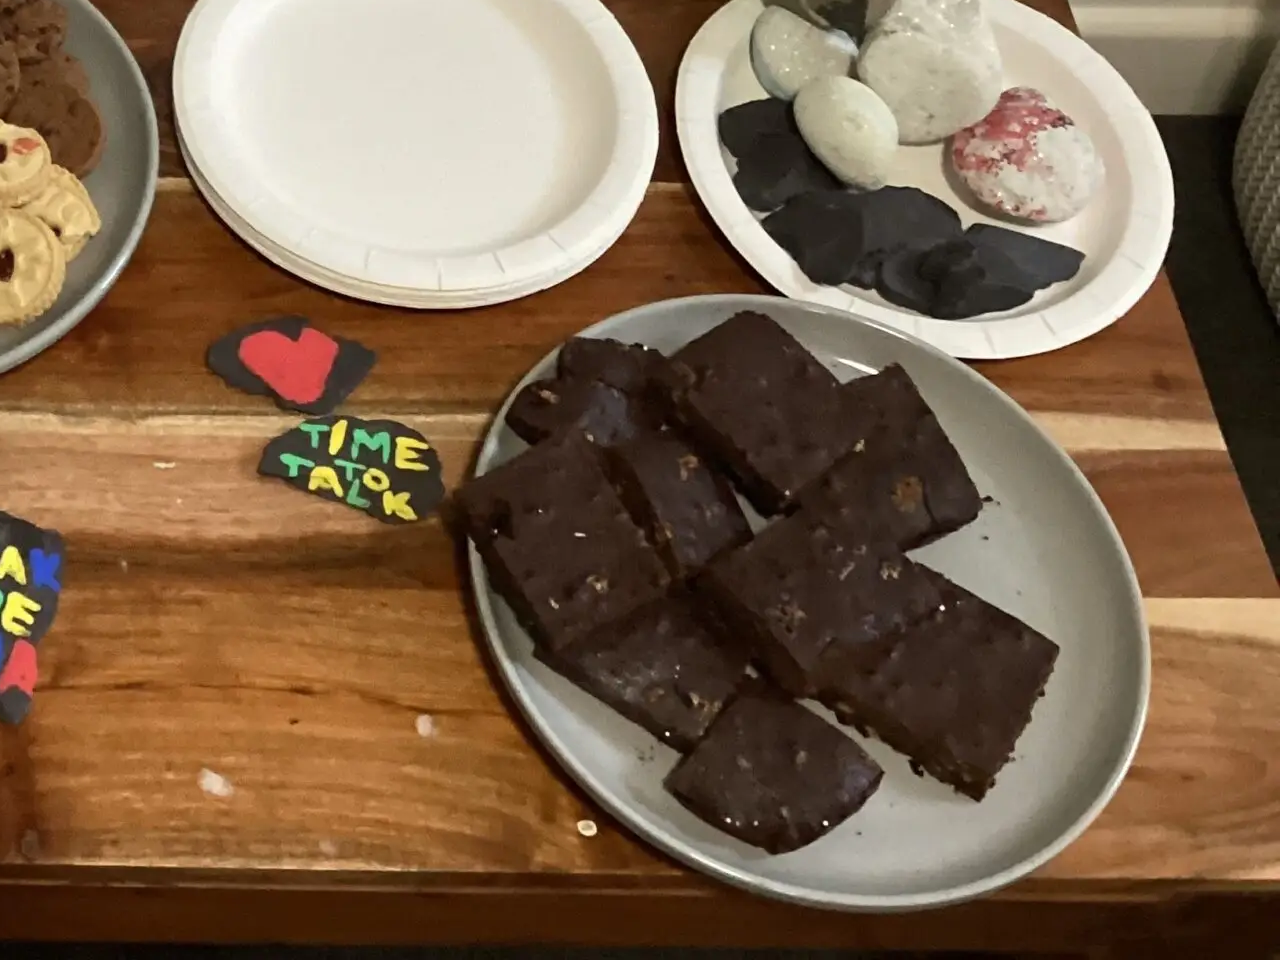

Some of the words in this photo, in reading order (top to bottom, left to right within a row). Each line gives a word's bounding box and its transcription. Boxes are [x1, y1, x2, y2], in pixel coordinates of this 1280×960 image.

[299, 420, 430, 471] TIME
[279, 453, 418, 521] TALK
[333, 459, 391, 492] TO
